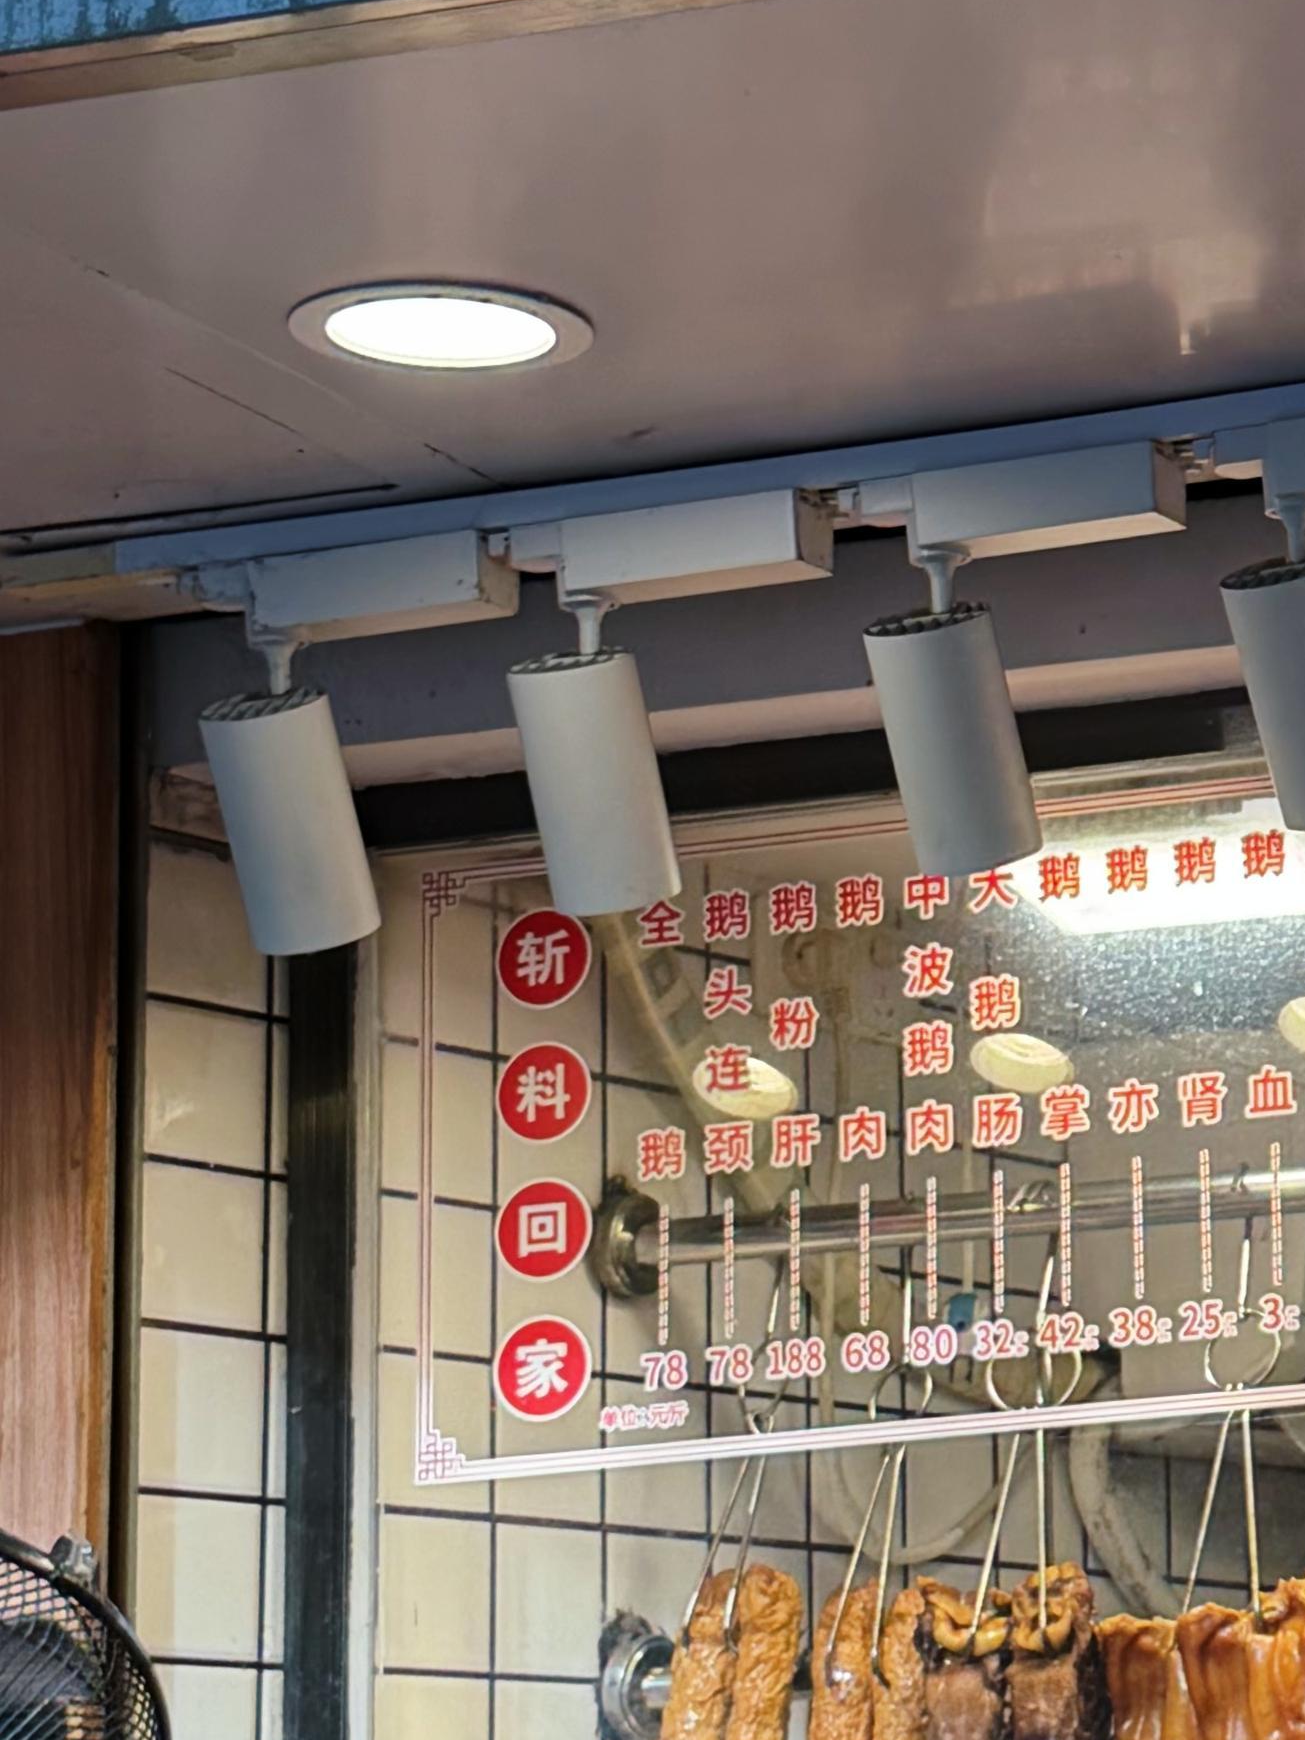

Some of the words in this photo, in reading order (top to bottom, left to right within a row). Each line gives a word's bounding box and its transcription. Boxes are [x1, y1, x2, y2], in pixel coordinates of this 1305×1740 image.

[514, 928, 573, 1400] 斩料回家
[1037, 1313, 1083, 1351] 42
[1110, 1306, 1157, 1347] 38
[1179, 1300, 1224, 1341] 25
[707, 1344, 751, 1383] 78
[767, 1338, 825, 1378] 188
[843, 1332, 890, 1371] 68
[911, 1325, 957, 1363] 80
[642, 1352, 687, 1389] 78
